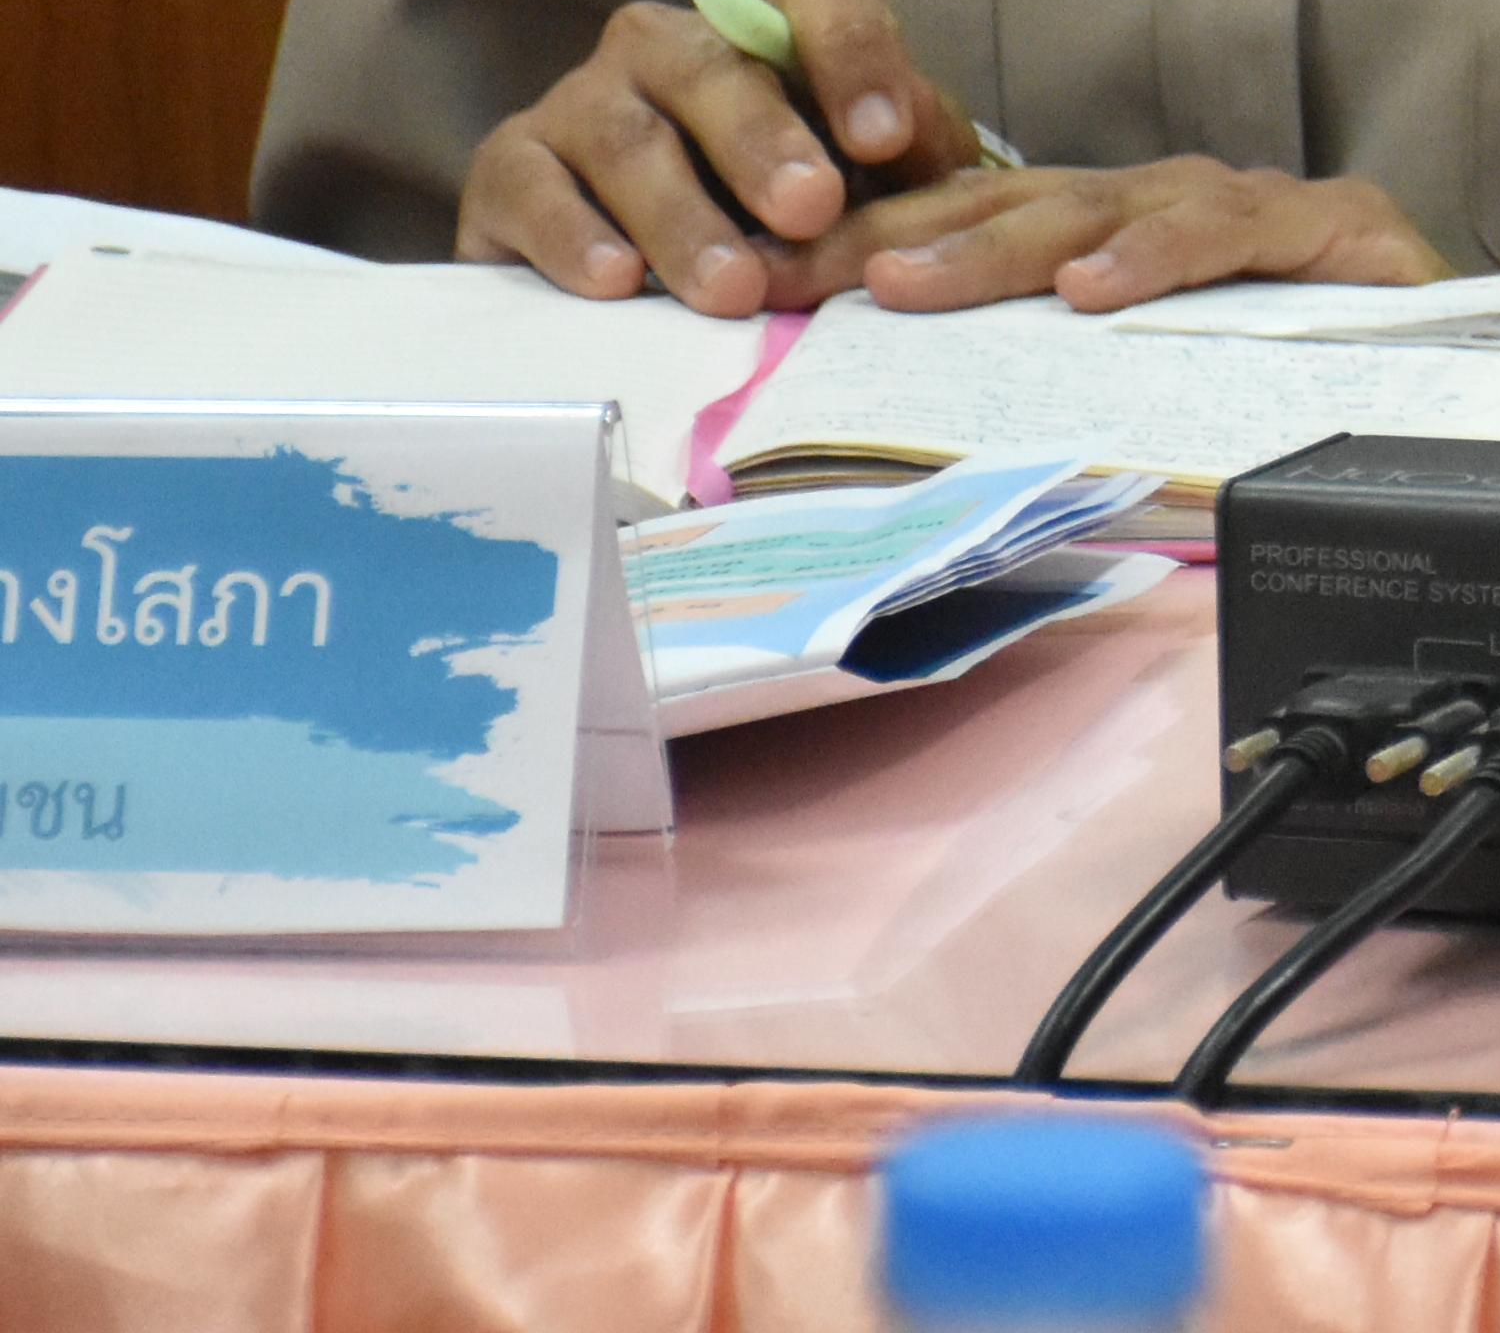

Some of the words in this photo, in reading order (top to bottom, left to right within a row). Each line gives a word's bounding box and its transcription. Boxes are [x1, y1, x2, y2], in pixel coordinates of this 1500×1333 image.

[1250, 543, 1437, 574] PROFESSIONAL
[1250, 570, 1418, 601] CONFERENCE
[0, 779, 127, 841] ชน
